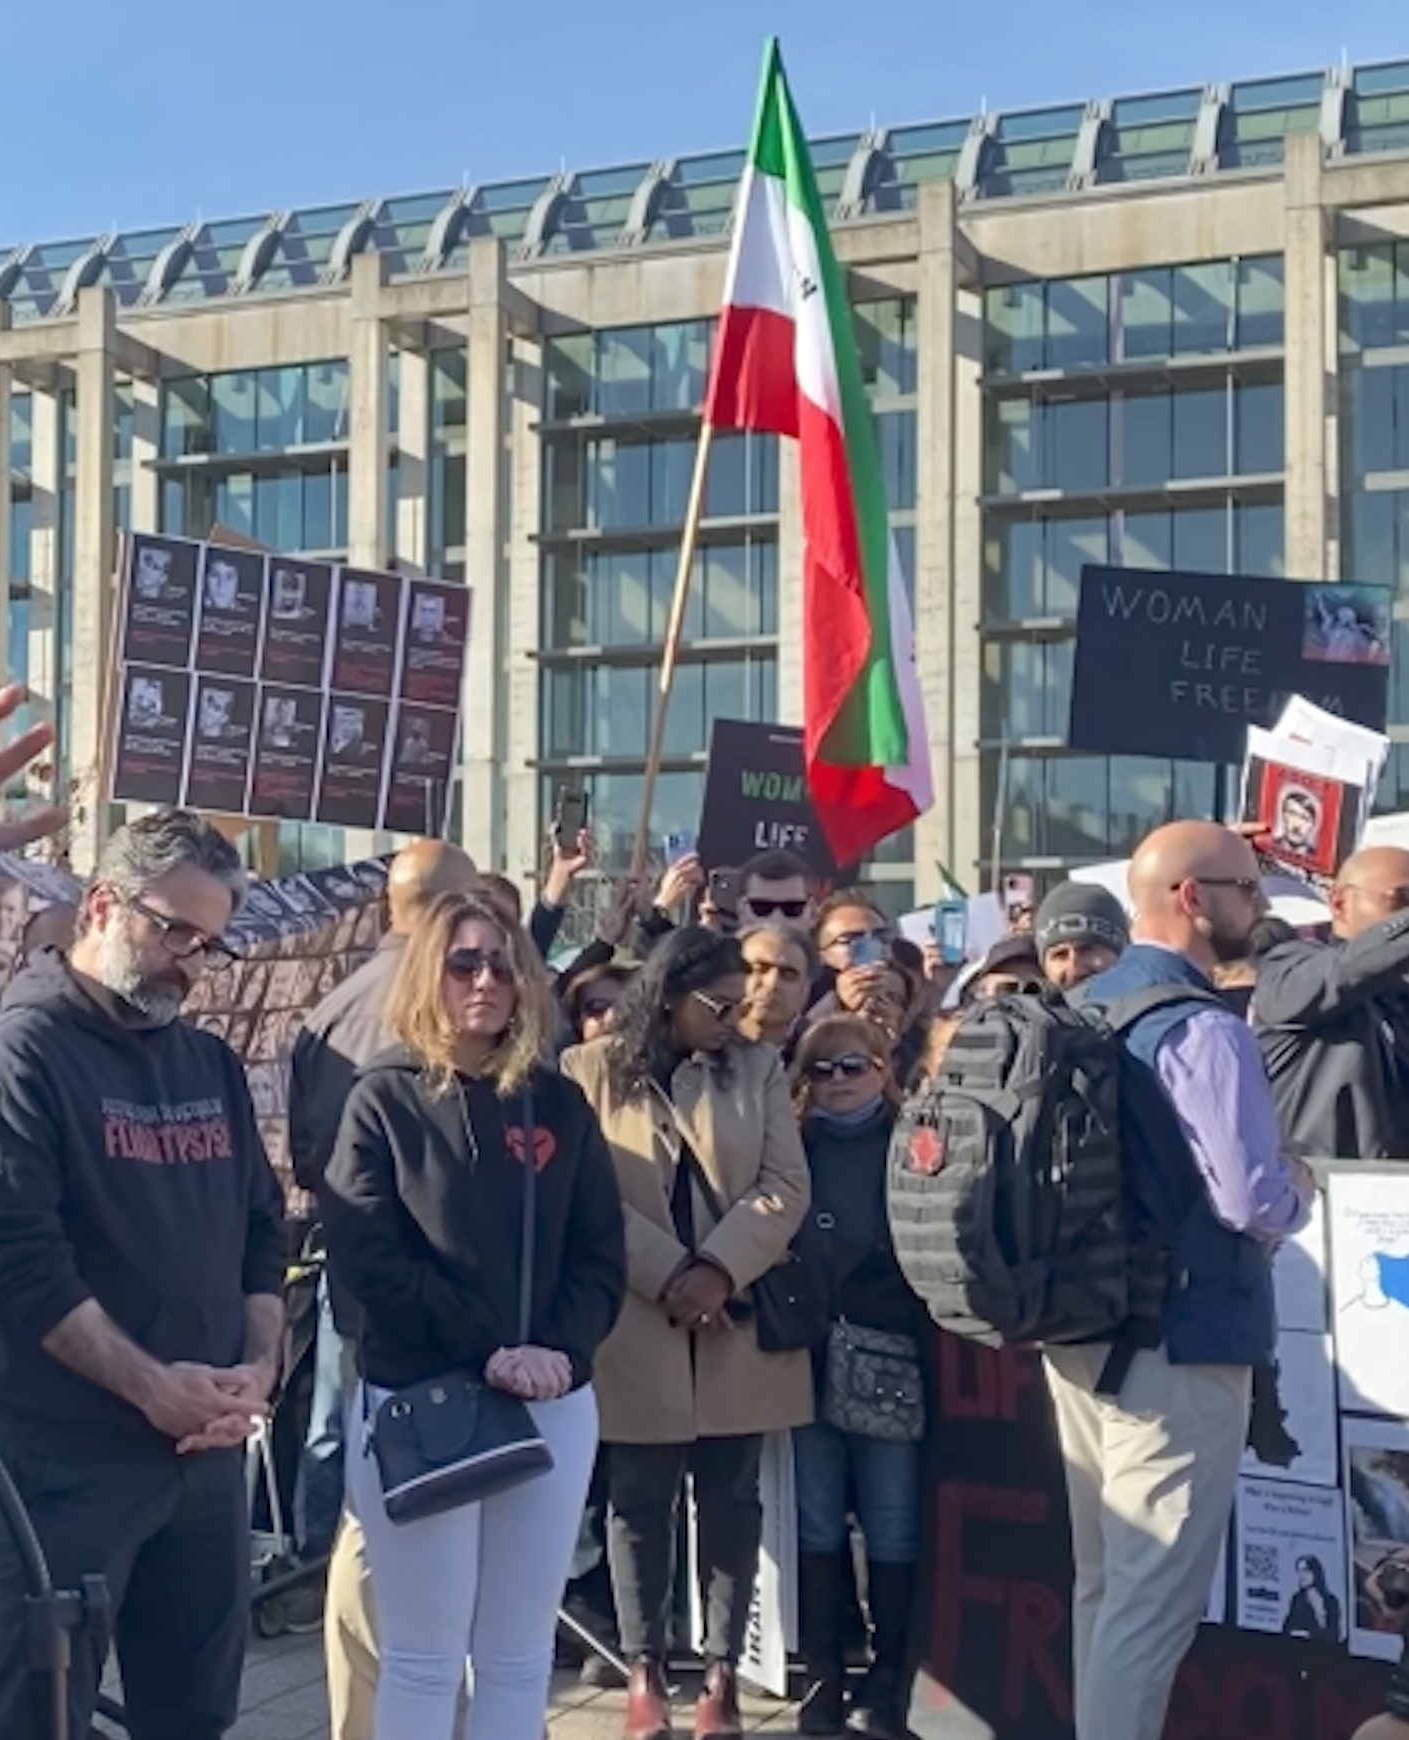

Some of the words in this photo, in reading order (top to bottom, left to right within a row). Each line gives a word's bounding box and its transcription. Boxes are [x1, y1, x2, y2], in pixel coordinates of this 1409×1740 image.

[1101, 584, 1268, 632] WOMAN
[1180, 640, 1263, 676] LIFE
[741, 769, 806, 802] WOM
[754, 820, 809, 852] LIFE
